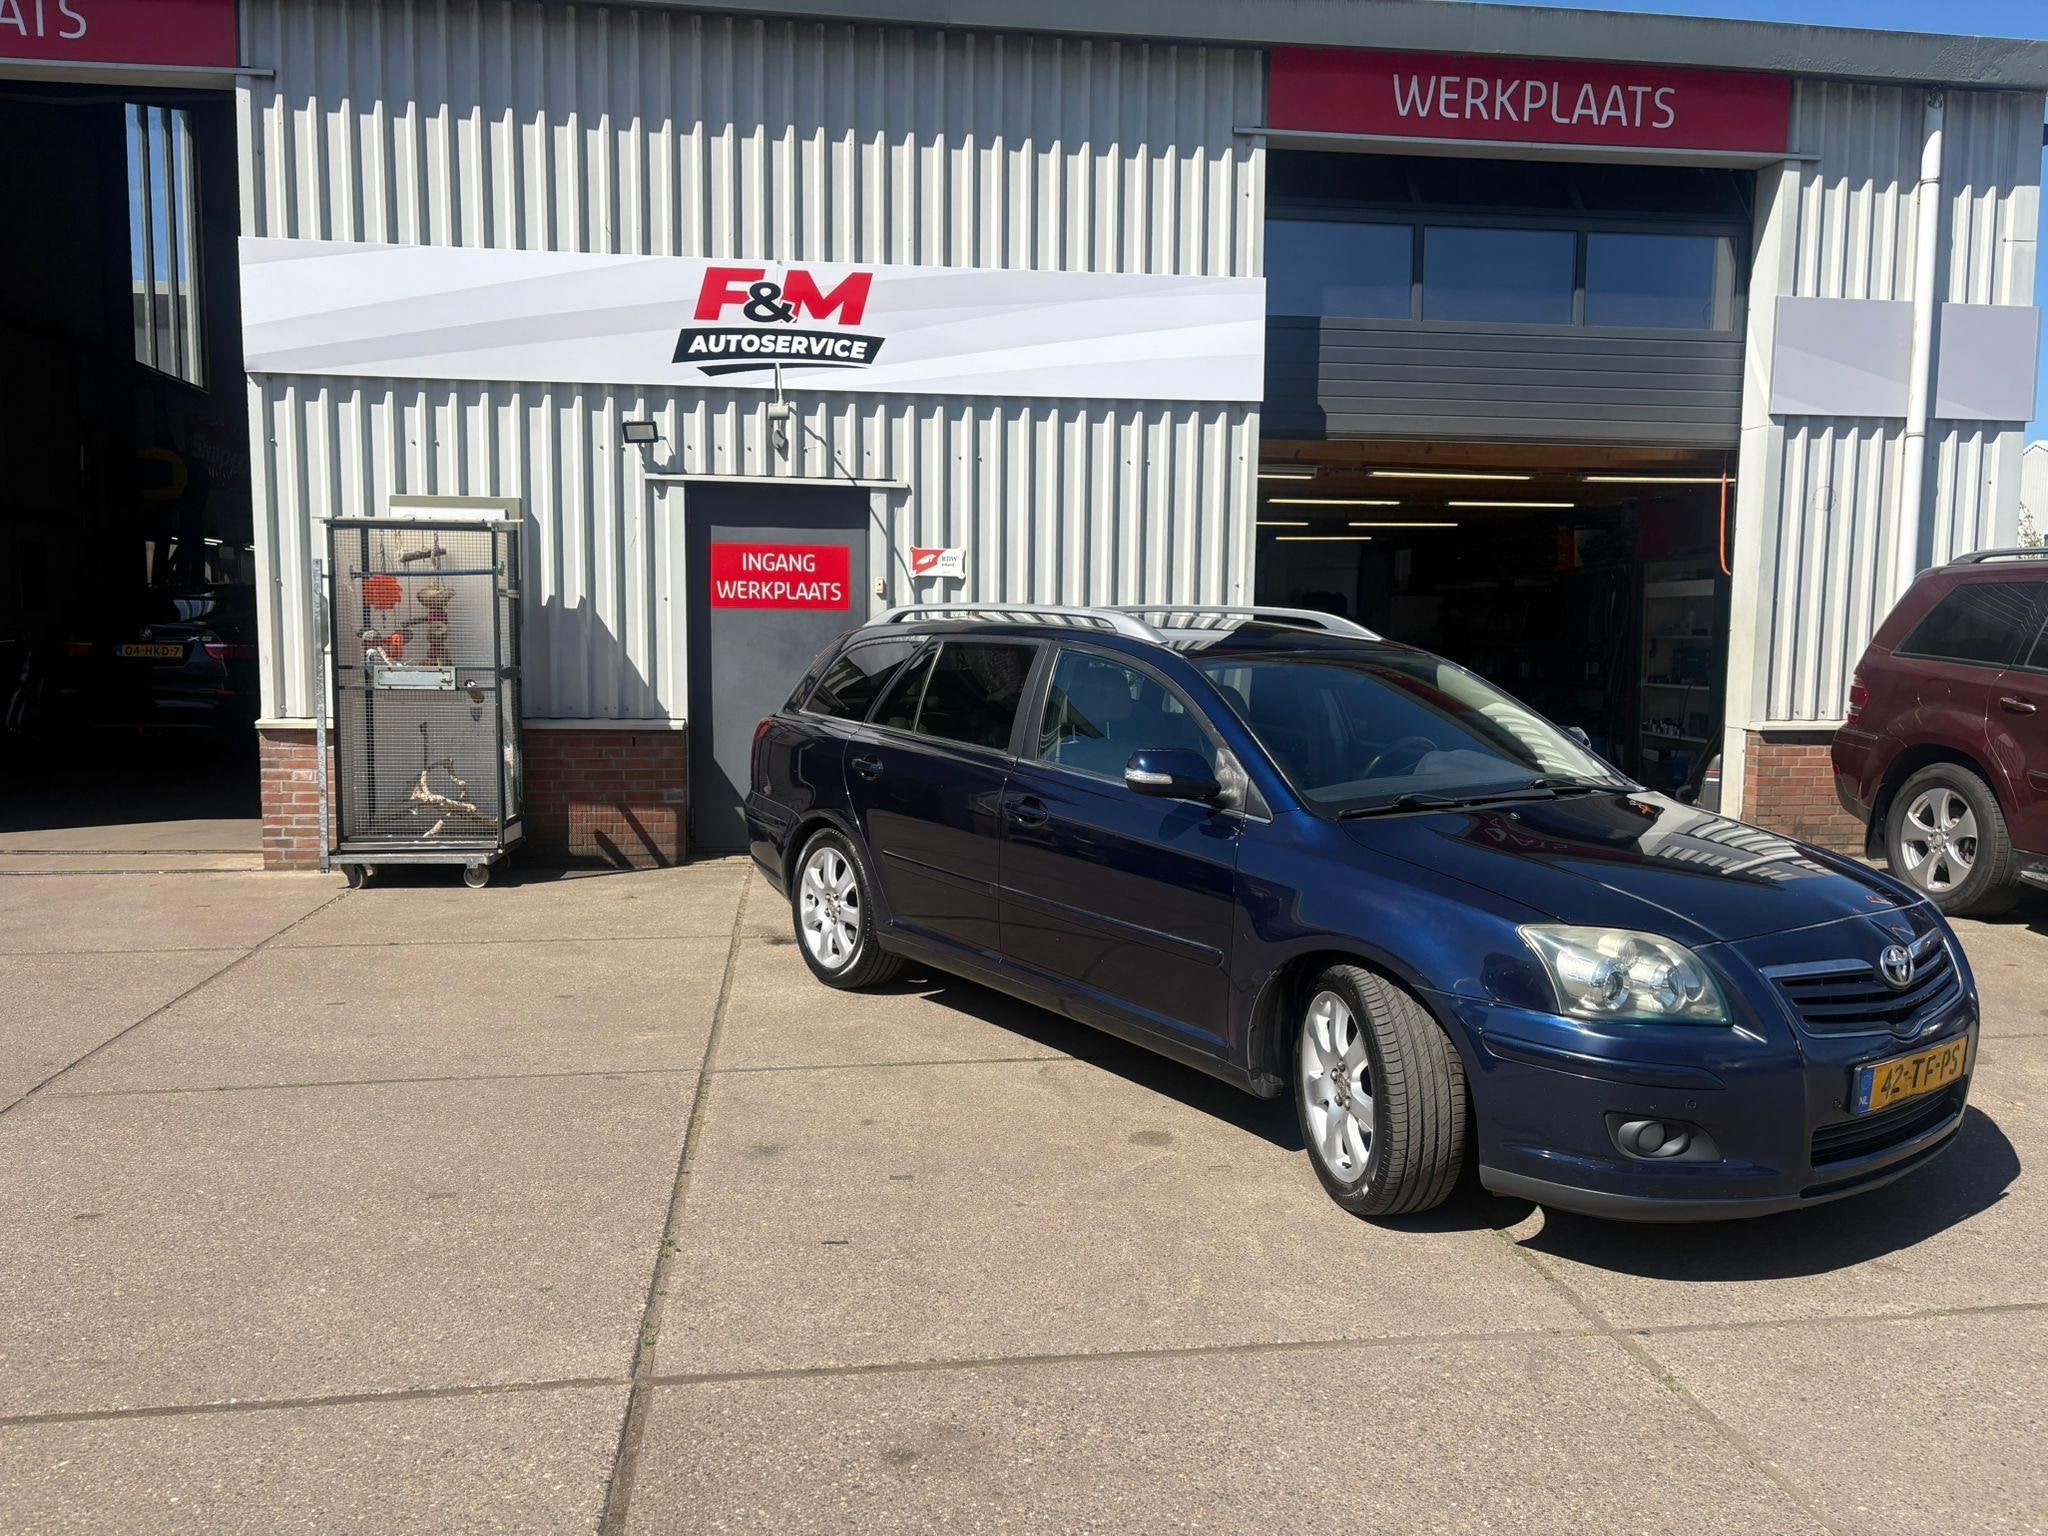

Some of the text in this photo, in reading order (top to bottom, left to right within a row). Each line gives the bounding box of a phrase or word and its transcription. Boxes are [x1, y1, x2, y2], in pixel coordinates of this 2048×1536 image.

[1393, 73, 1675, 129] WERKPLAATS
[693, 266, 873, 326] F&M
[687, 334, 868, 360] AUTOSERVICE
[742, 552, 816, 573] INGANG
[716, 580, 842, 602] WERKPLAATS
[1881, 1043, 1960, 1100] 42-TF-PS
